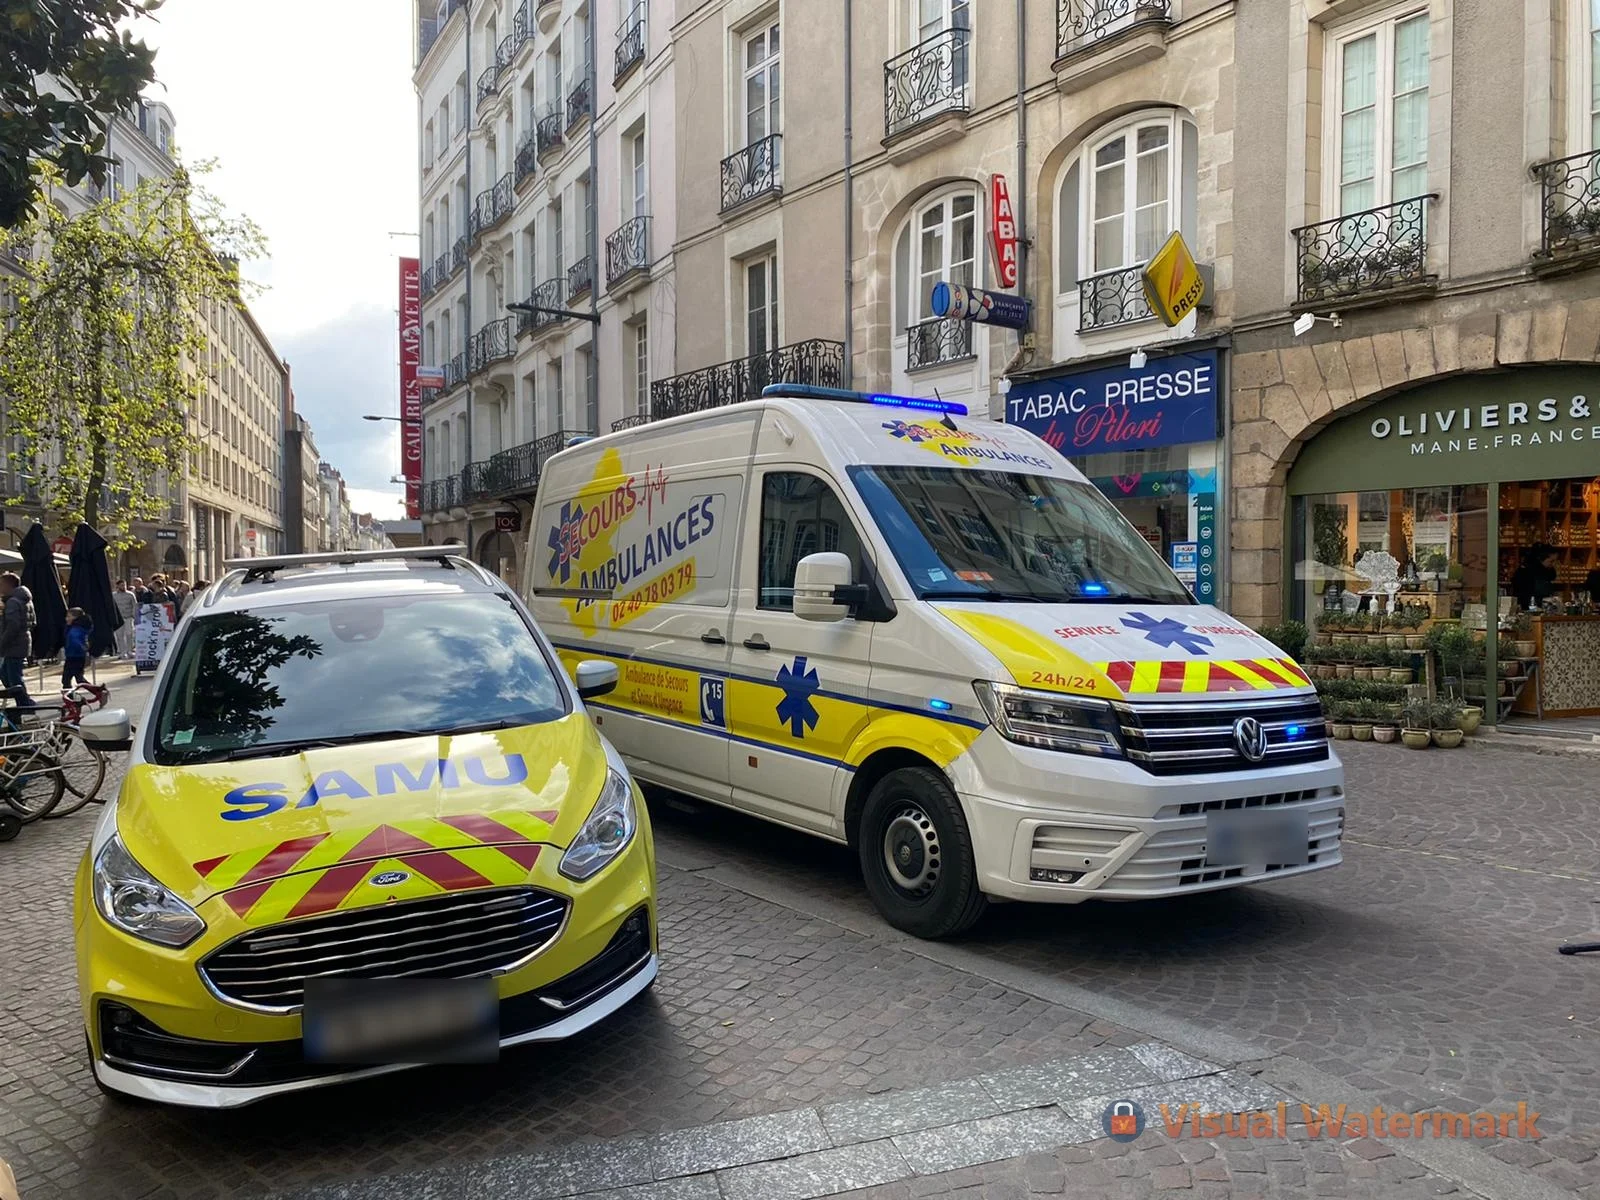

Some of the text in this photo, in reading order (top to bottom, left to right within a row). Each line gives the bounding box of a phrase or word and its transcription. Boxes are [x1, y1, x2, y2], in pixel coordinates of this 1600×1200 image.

[996, 176, 1016, 285] TABAC
[1172, 274, 1203, 318] PRESSE
[1010, 366, 1211, 422] TABAC PRESSE
[1040, 401, 1163, 449] du Pilori
[1370, 395, 1591, 438] OLIVIERS &
[940, 443, 1053, 470] AMBULANCES
[560, 477, 637, 565] SECOURS
[575, 496, 714, 612] AMBULANCES
[612, 563, 693, 622] 02 40 78 03 79
[1054, 625, 1121, 639] SERVICE
[625, 665, 689, 693] Ambulance de Secours
[711, 683, 722, 700] 15
[1032, 671, 1097, 691] 24h/24
[220, 753, 529, 821] SAMU
[377, 873, 402, 884] Ford
